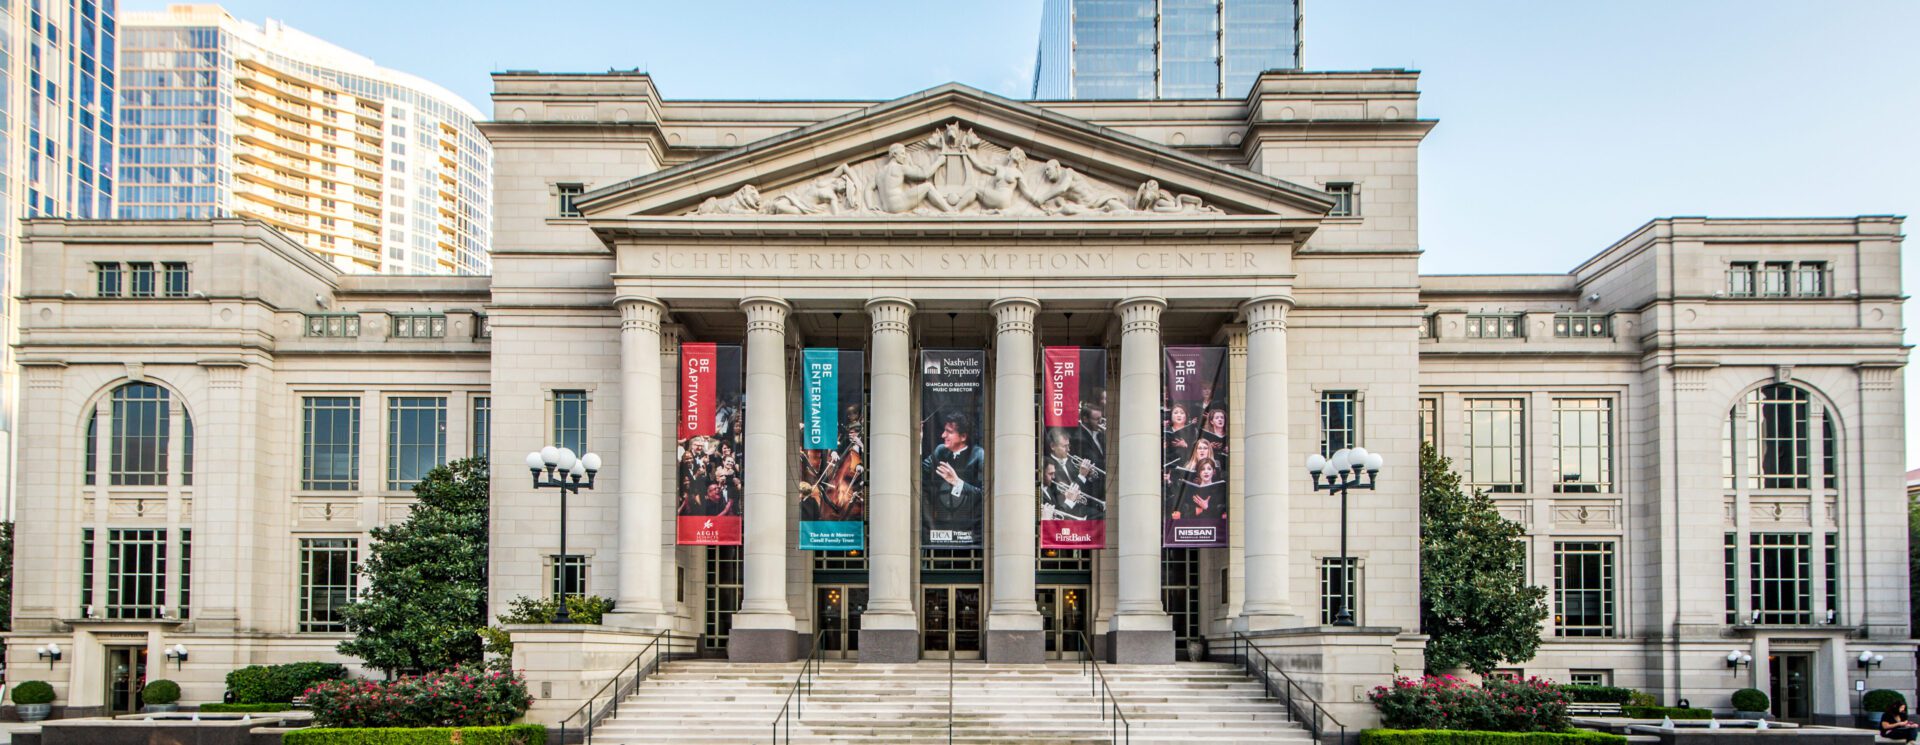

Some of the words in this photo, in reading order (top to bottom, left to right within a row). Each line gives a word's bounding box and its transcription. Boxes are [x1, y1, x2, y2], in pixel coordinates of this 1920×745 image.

[650, 252, 915, 270] SCHERMERHORN
[940, 252, 1113, 270] SYMPHONY
[1135, 252, 1257, 269] CENTER
[700, 358, 710, 373] BE
[943, 358, 979, 366] Nashville
[1064, 362, 1074, 377] BE
[1186, 360, 1196, 375] BE
[822, 363, 832, 378] BE
[943, 367, 981, 377] Symphony
[1175, 360, 1185, 391] HERE
[688, 358, 699, 430] CAPTIVATED
[1054, 362, 1063, 416] INSPIRED
[811, 363, 821, 444] ENTERTAINED
[1055, 532, 1092, 542] FirstBank
